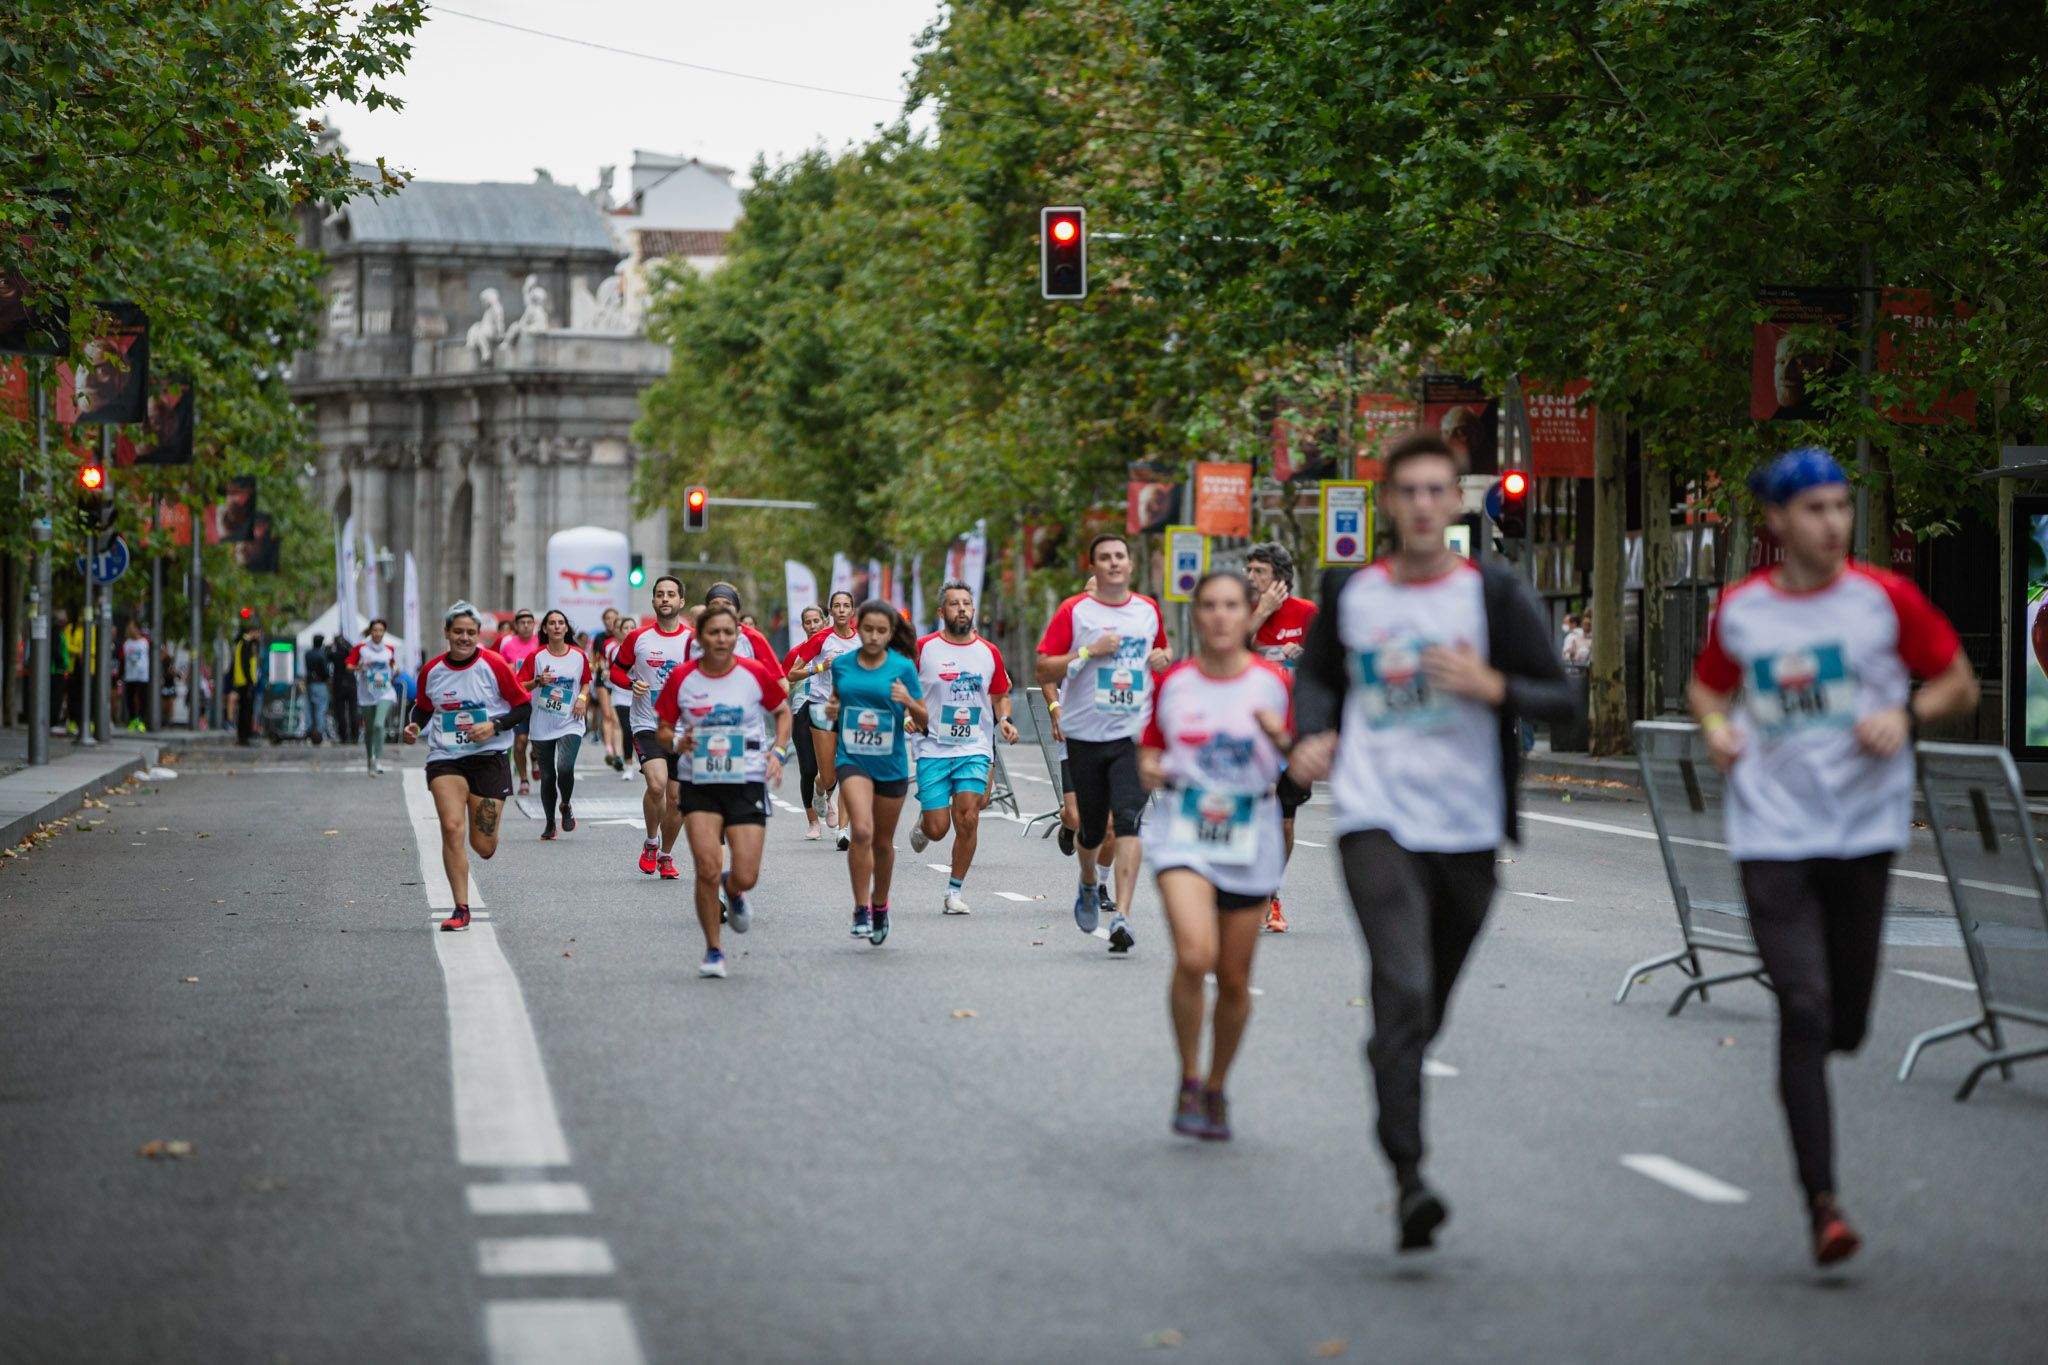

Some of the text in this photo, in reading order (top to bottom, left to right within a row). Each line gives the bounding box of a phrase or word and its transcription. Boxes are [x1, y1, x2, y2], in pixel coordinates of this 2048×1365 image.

[1109, 689, 1133, 705] 549
[546, 699, 561, 711] 545
[456, 731, 472, 744] 53
[950, 725, 971, 738] 529
[853, 731, 882, 746] 1225
